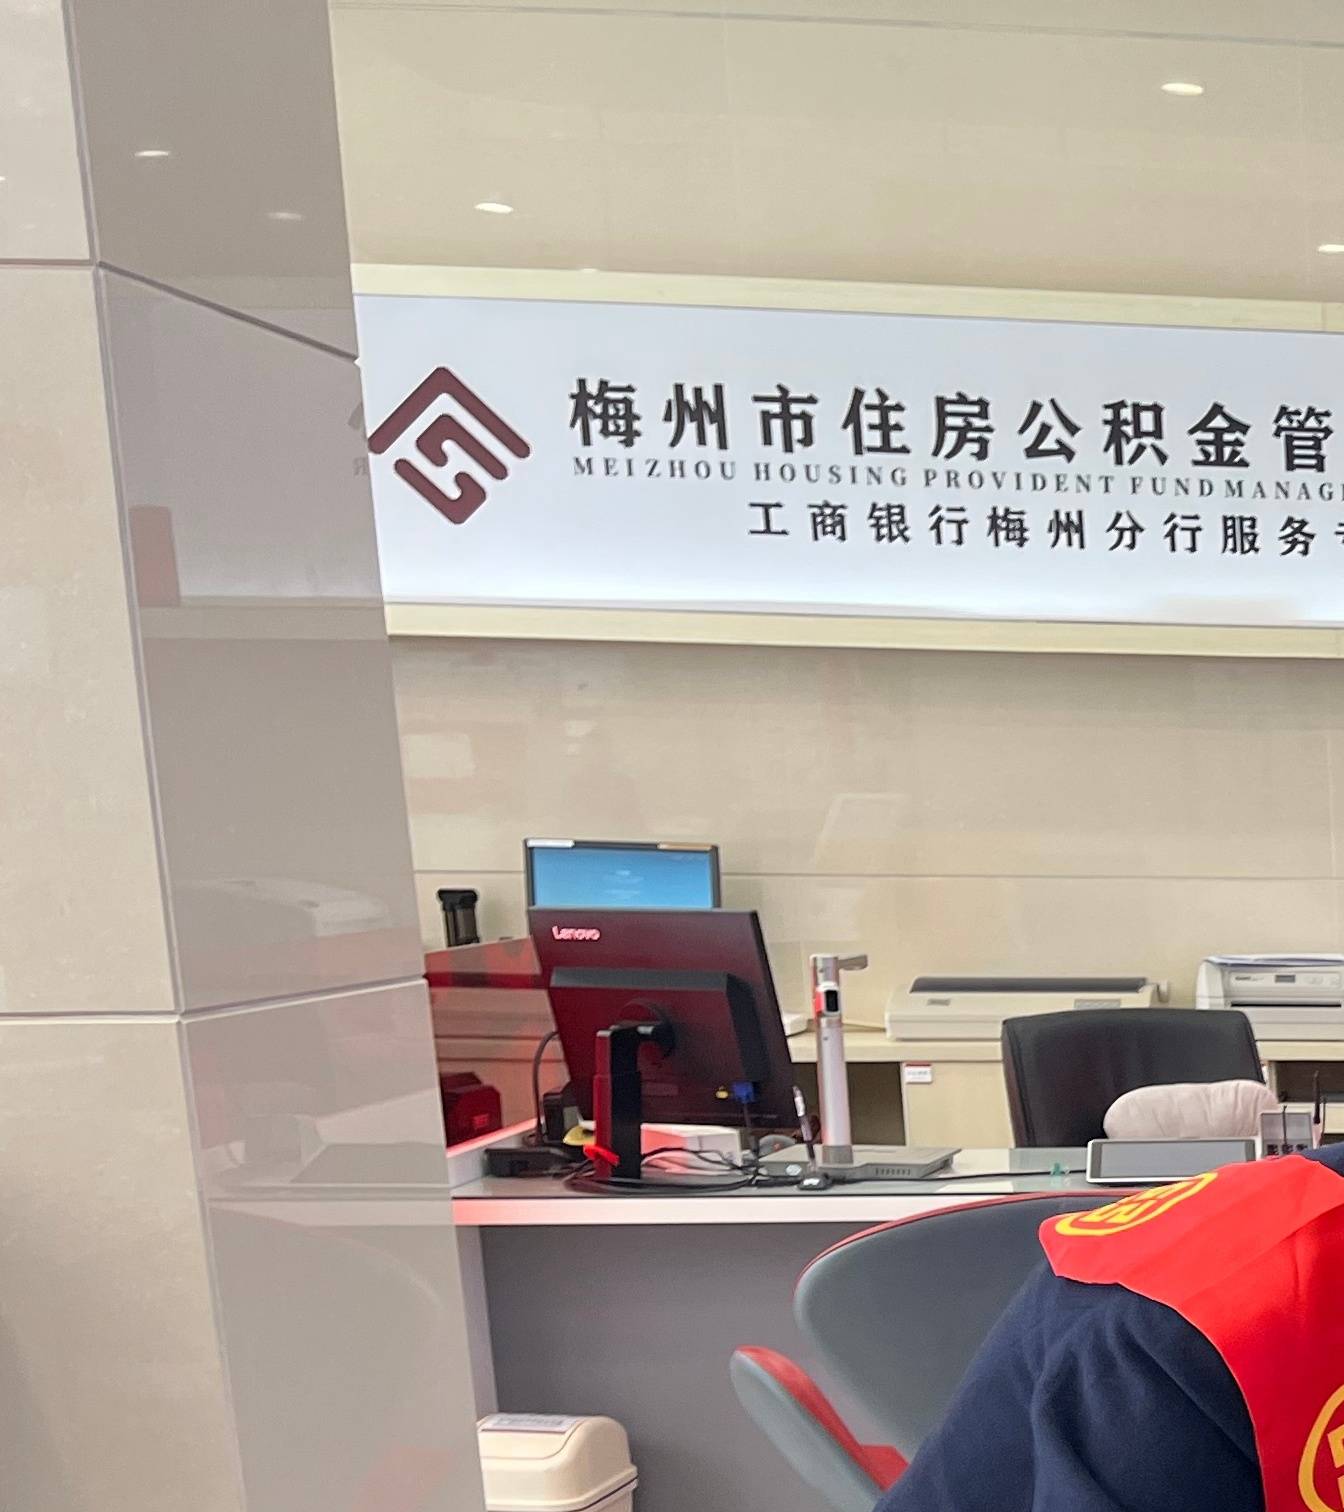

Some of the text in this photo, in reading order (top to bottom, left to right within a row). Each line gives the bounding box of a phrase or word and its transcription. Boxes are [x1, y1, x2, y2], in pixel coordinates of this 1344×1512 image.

[572, 456, 737, 482] MEIZHOU
[753, 461, 909, 488] HOUSING
[922, 467, 1116, 496] PROVIDENT
[552, 925, 601, 941] Lenovo
